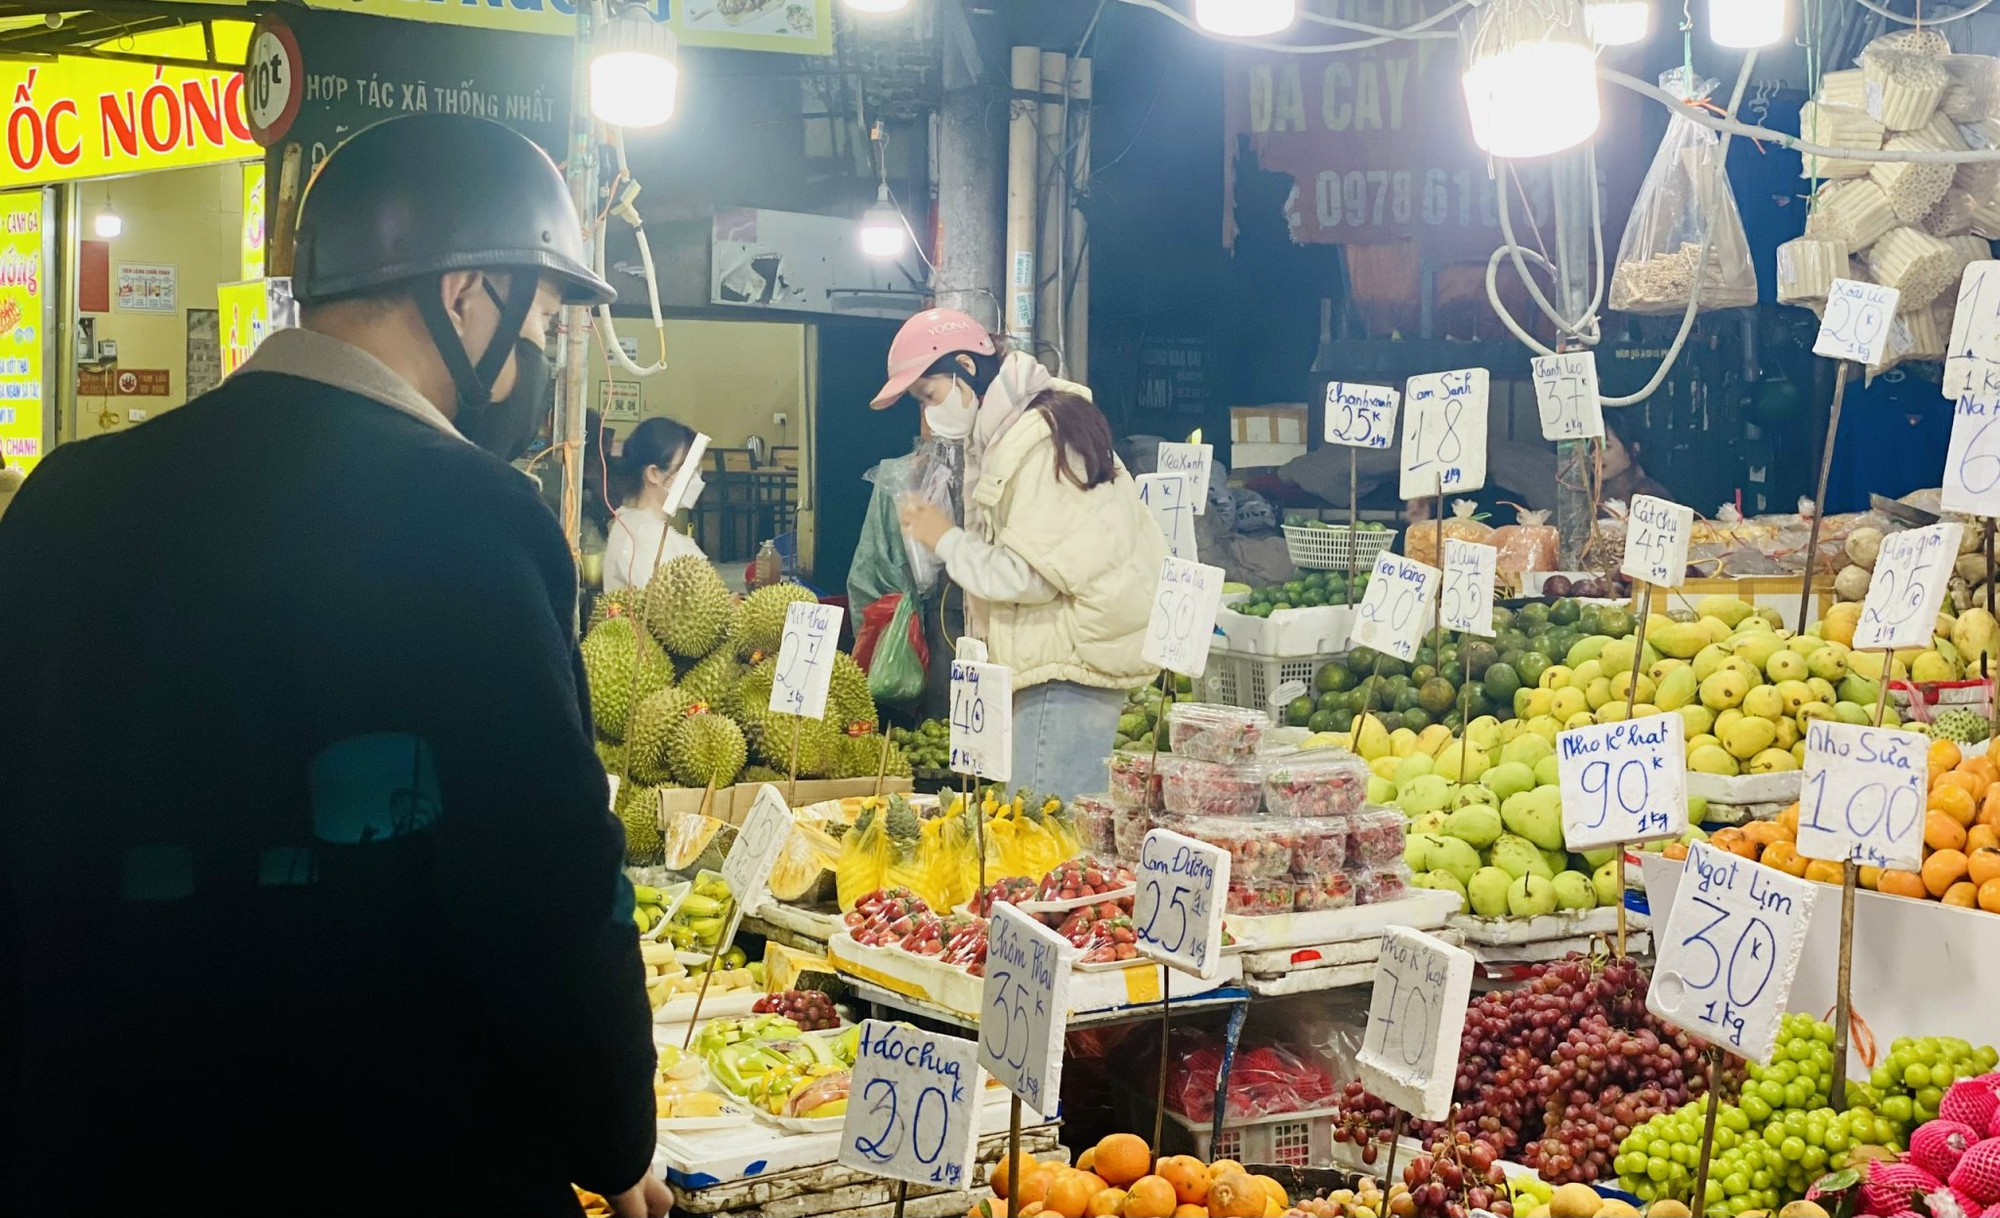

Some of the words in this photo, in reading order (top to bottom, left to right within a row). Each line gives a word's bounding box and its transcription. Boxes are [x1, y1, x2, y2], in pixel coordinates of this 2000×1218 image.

[8, 68, 81, 170] ỐC
[307, 74, 348, 110] HỢP
[356, 73, 394, 109] TÁC
[402, 80, 428, 112] XÃ
[434, 79, 498, 118] THỐNG
[506, 84, 555, 122] NHẤT
[1408, 399, 1463, 471] 18
[1627, 721, 1669, 753] hạt
[1855, 731, 1912, 770] Sữa
[1143, 836, 1169, 875] Cam
[1685, 845, 1739, 901] Ngọt
[989, 914, 1026, 969] Chôm
